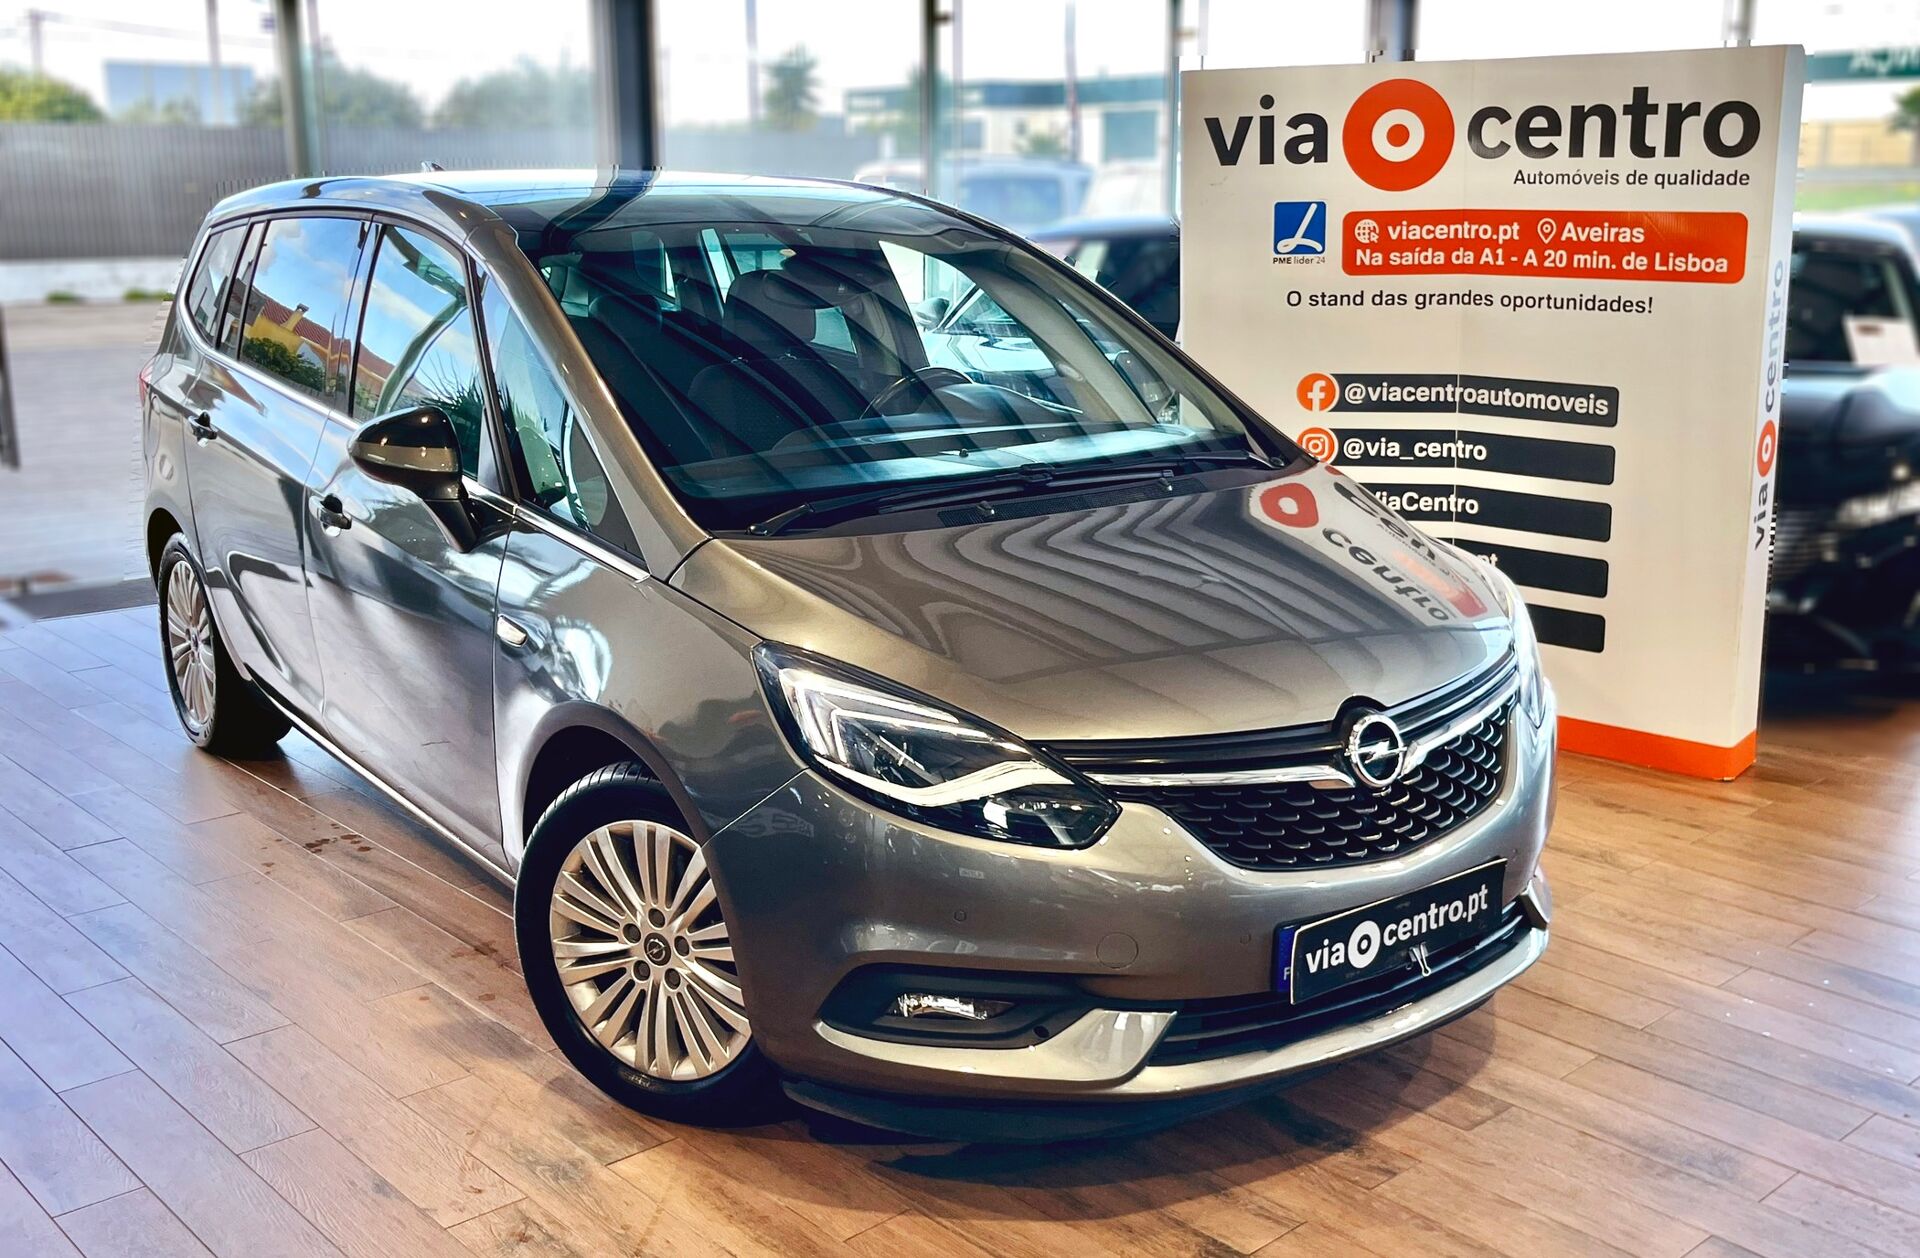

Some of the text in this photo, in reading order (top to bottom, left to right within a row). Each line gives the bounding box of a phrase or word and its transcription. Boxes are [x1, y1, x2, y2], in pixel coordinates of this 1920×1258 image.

[1204, 86, 1761, 166] via centro
[1513, 169, 1750, 189] Automóveis de qualidade
[1387, 220, 1645, 244] viacentro.pt Aveiras
[1272, 257, 1292, 265] PME
[1356, 248, 1383, 266] Na
[1389, 247, 1445, 266] saída
[1451, 247, 1475, 265] da
[1479, 248, 1505, 265] A1
[1522, 249, 1538, 267] A
[1543, 250, 1567, 268] 20
[1573, 251, 1616, 270] min.
[1622, 252, 1648, 270] de
[1654, 252, 1728, 273] Lisboa
[1286, 290, 1653, 314] O stand das grandes oportunidades!
[1344, 382, 1609, 416] @viacentroautomoveis
[1754, 482, 1769, 551] via
[1765, 259, 1784, 413] centro
[1343, 437, 1487, 461] @via_centro
[1305, 884, 1489, 974] via centro.pt
